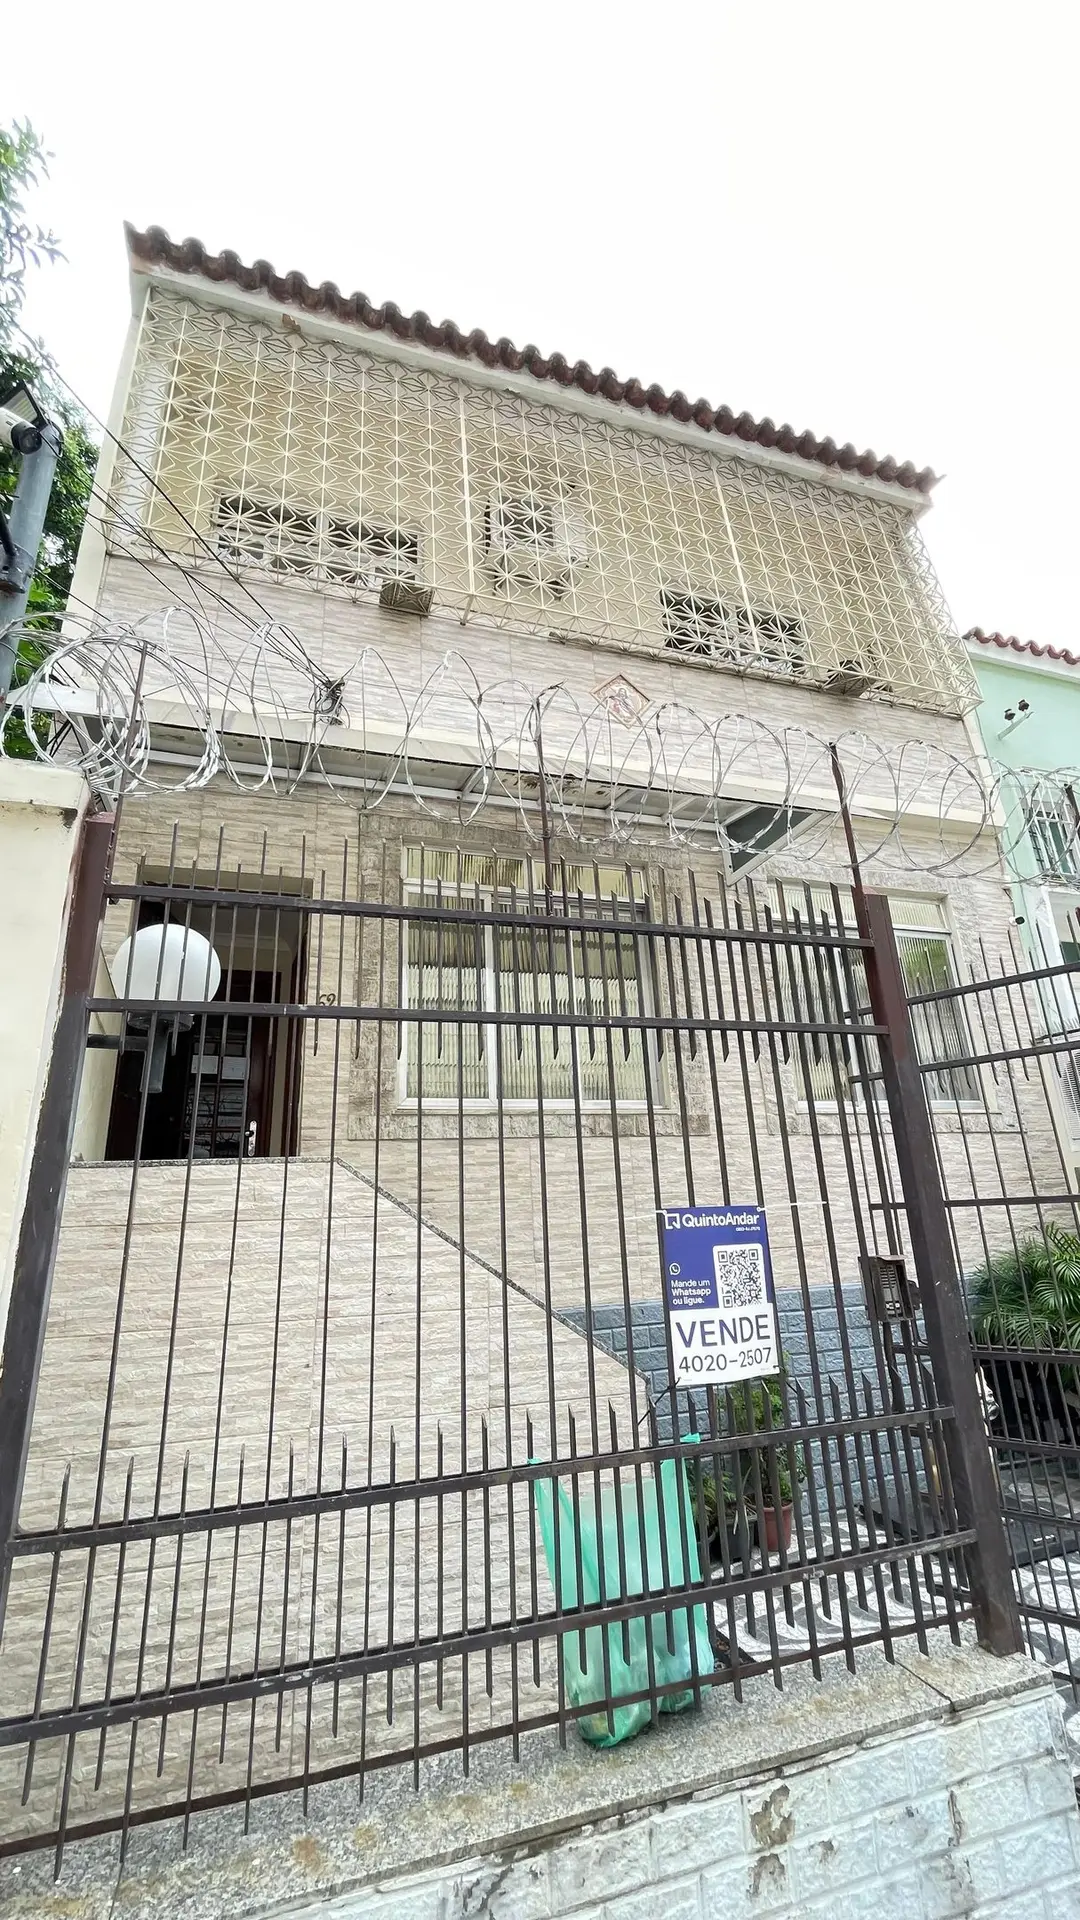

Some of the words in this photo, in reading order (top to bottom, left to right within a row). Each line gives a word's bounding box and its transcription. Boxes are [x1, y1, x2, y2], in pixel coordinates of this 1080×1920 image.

[682, 1212, 760, 1228] QuintoAndar
[671, 1279, 697, 1288] Mande
[671, 1287, 711, 1297] Whatsapp
[683, 1296, 705, 1306] ligue.
[675, 1314, 771, 1348] VENDE
[679, 1347, 771, 1373] 4020-2507
